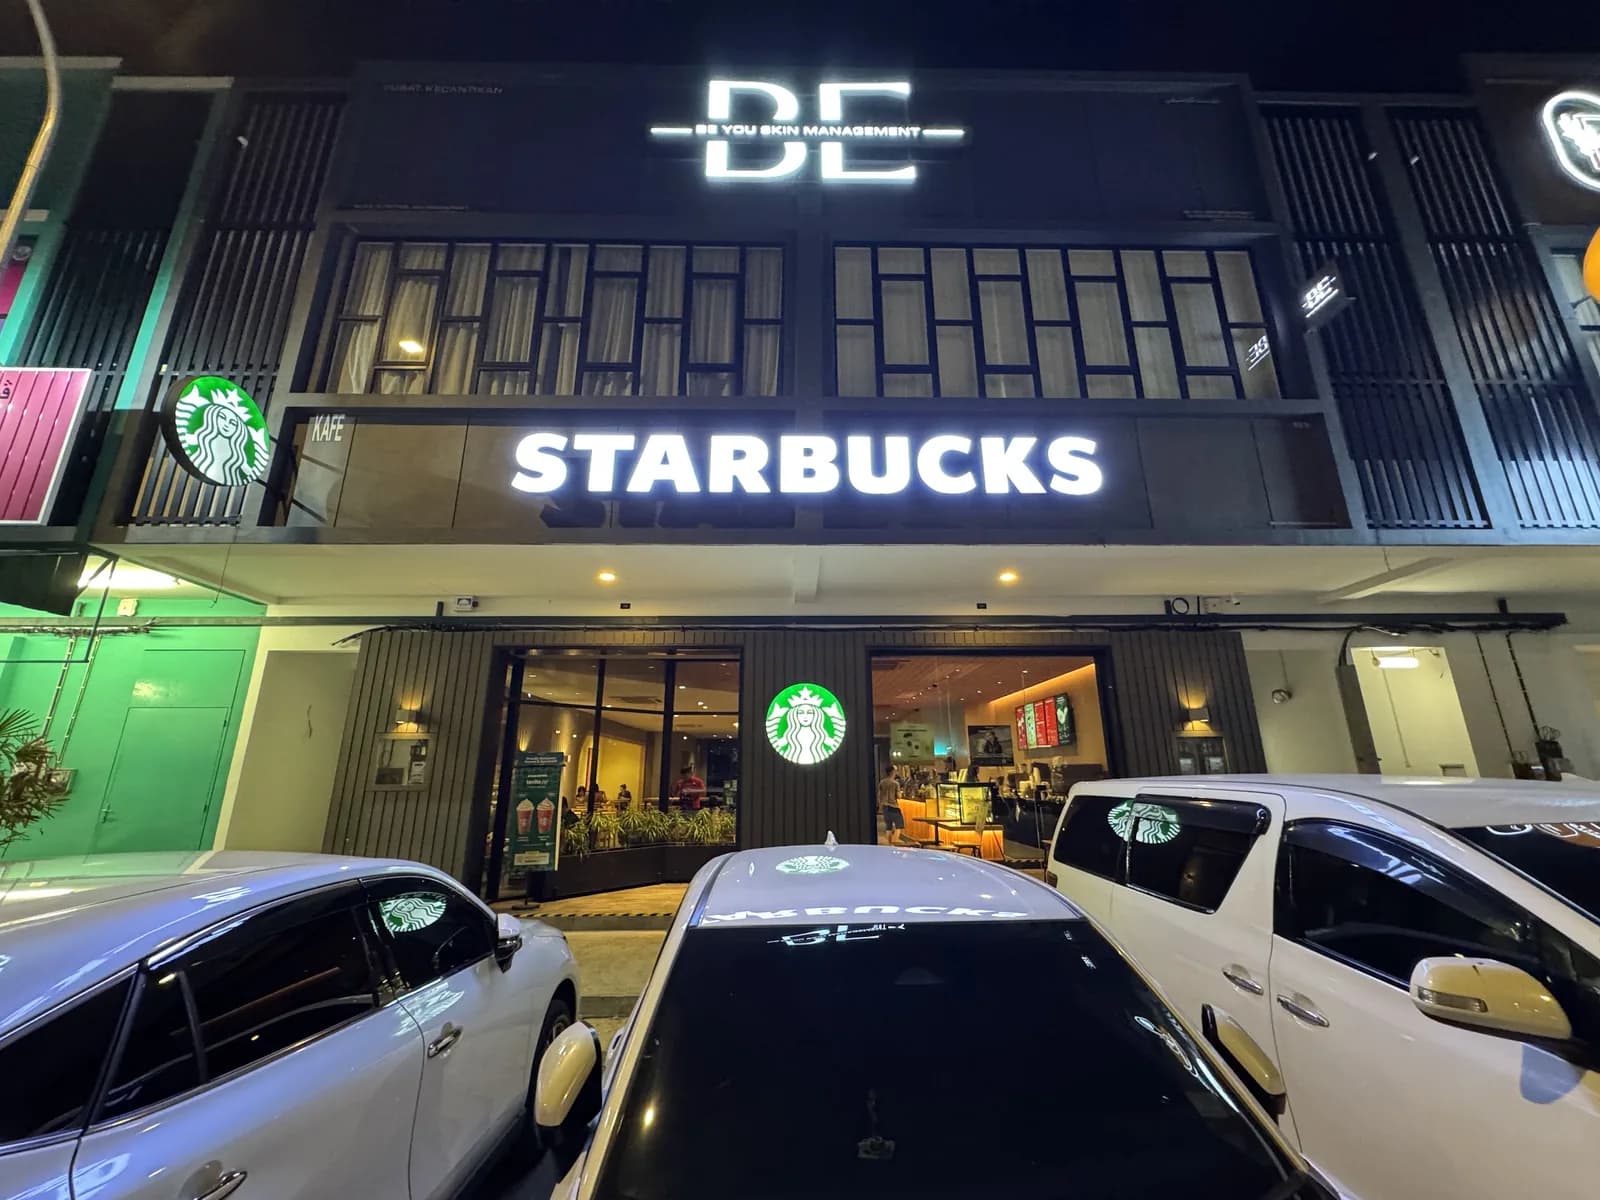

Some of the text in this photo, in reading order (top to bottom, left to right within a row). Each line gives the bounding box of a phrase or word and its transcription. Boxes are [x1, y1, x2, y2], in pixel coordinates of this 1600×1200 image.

[722, 124, 757, 136] YOU
[761, 125, 799, 136] SKIN
[802, 126, 921, 137] MANAGEMENT
[311, 415, 345, 441] KAFE
[511, 433, 1104, 496] STARBUCKS
